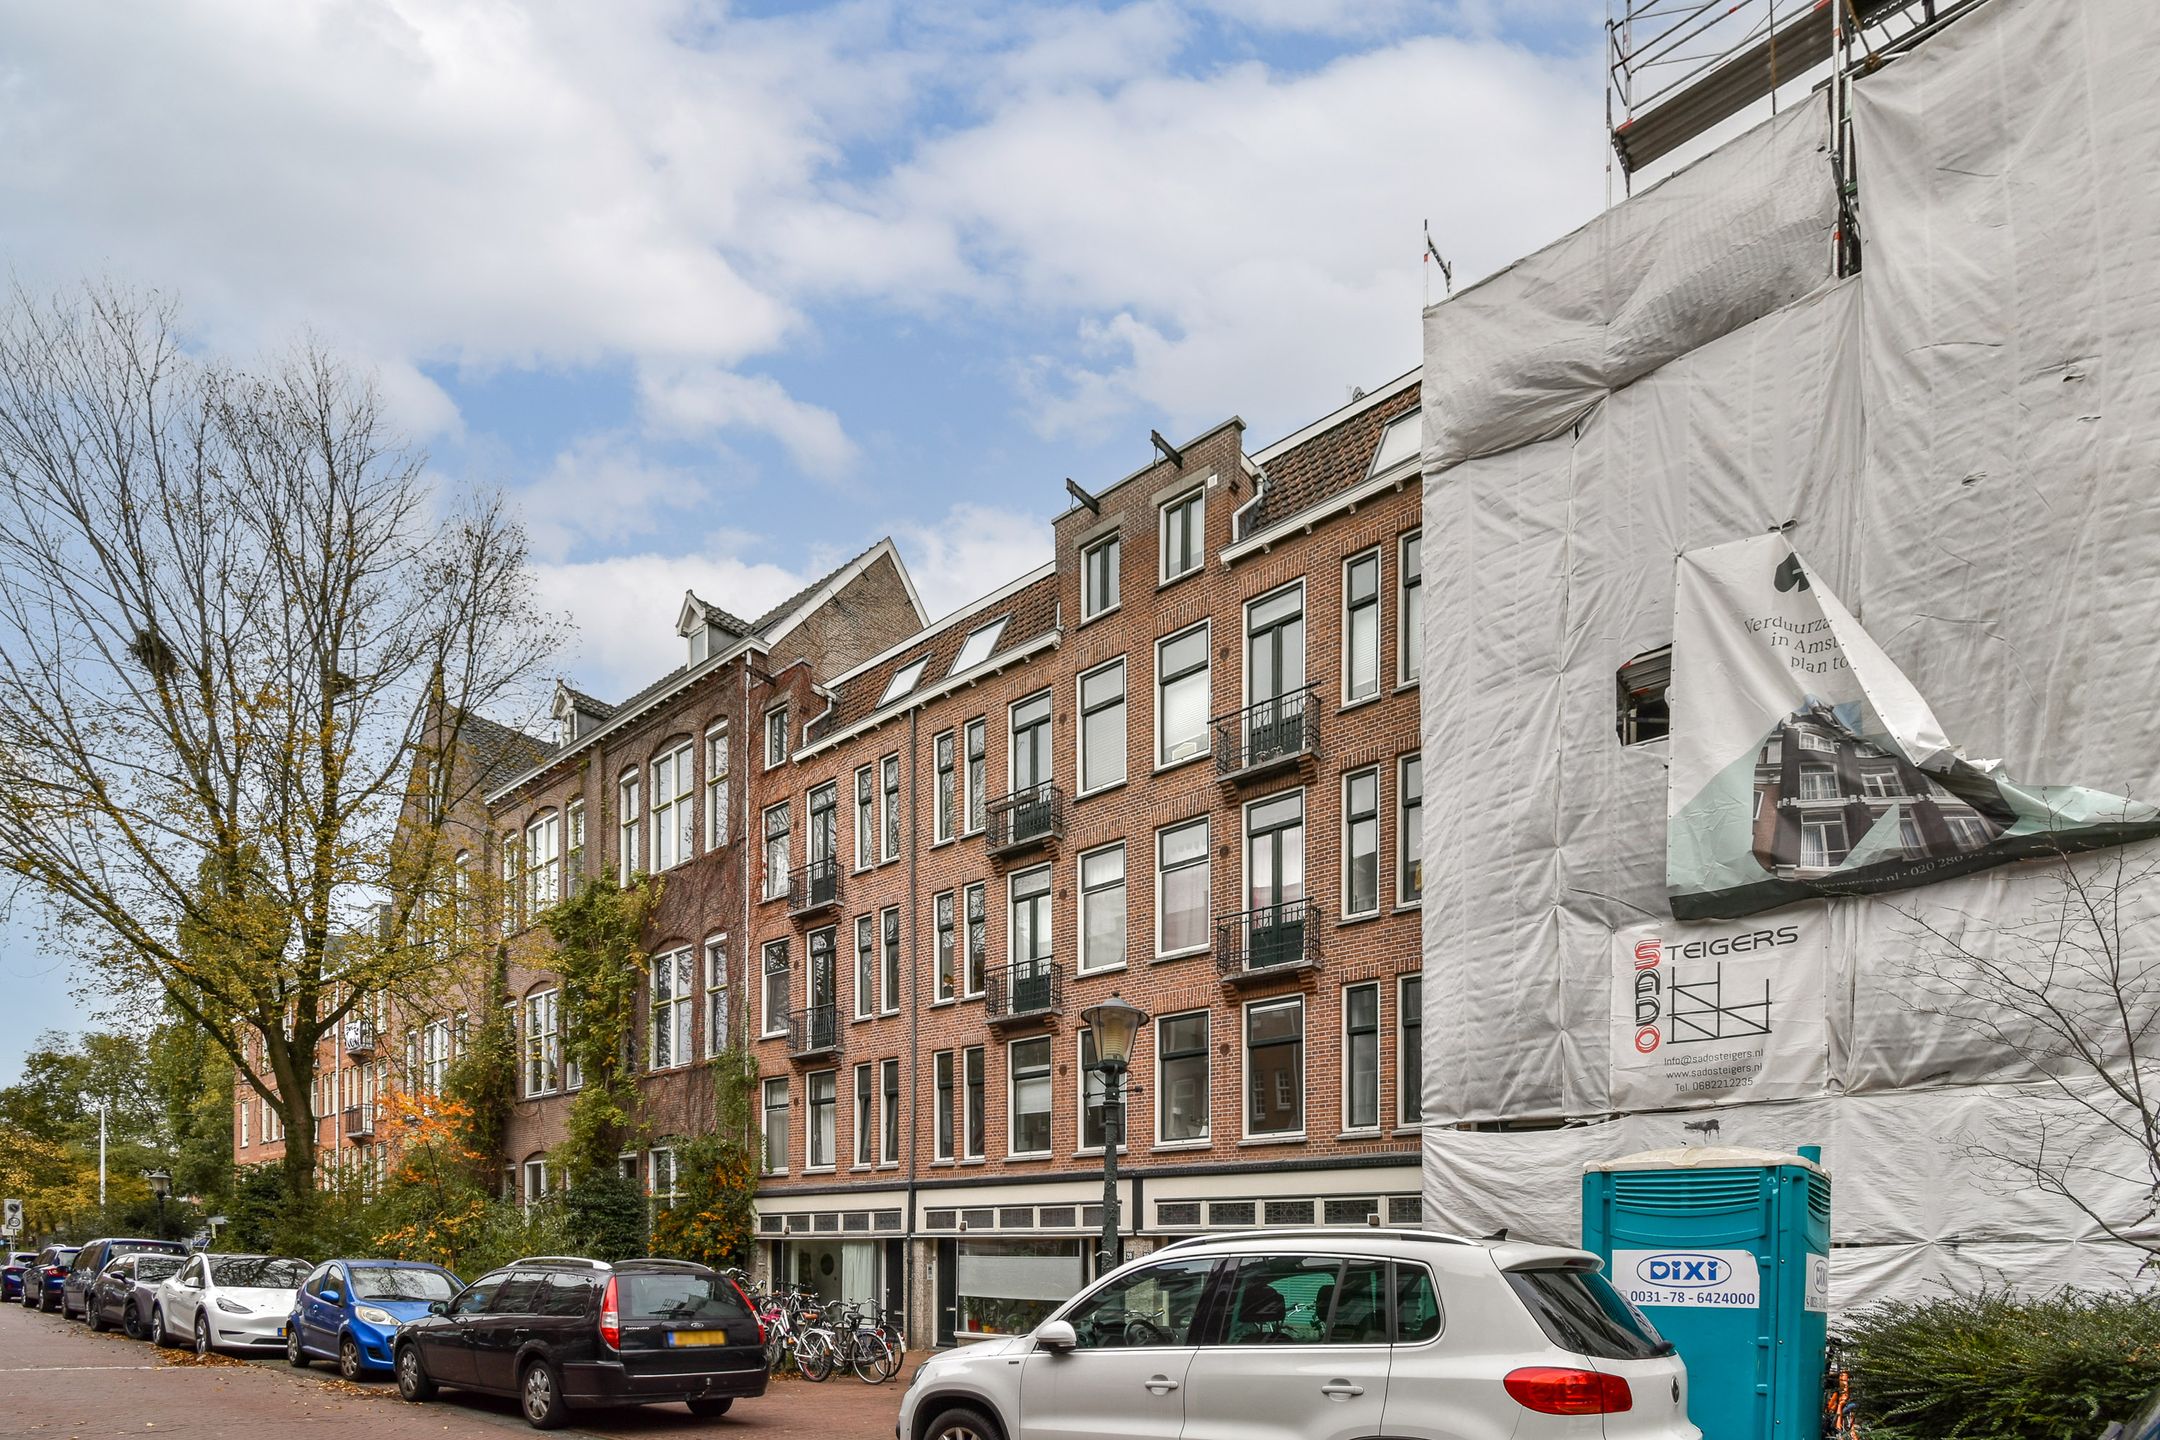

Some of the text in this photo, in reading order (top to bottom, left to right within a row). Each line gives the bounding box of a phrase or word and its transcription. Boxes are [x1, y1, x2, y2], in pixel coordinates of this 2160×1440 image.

[1770, 632, 1789, 646] in
[1791, 656, 1827, 673] plan
[1910, 862, 1935, 876] 020
[1666, 1063, 1763, 1079] www.sadosteigers.nl
[1692, 1077, 1754, 1091] 0682212235
